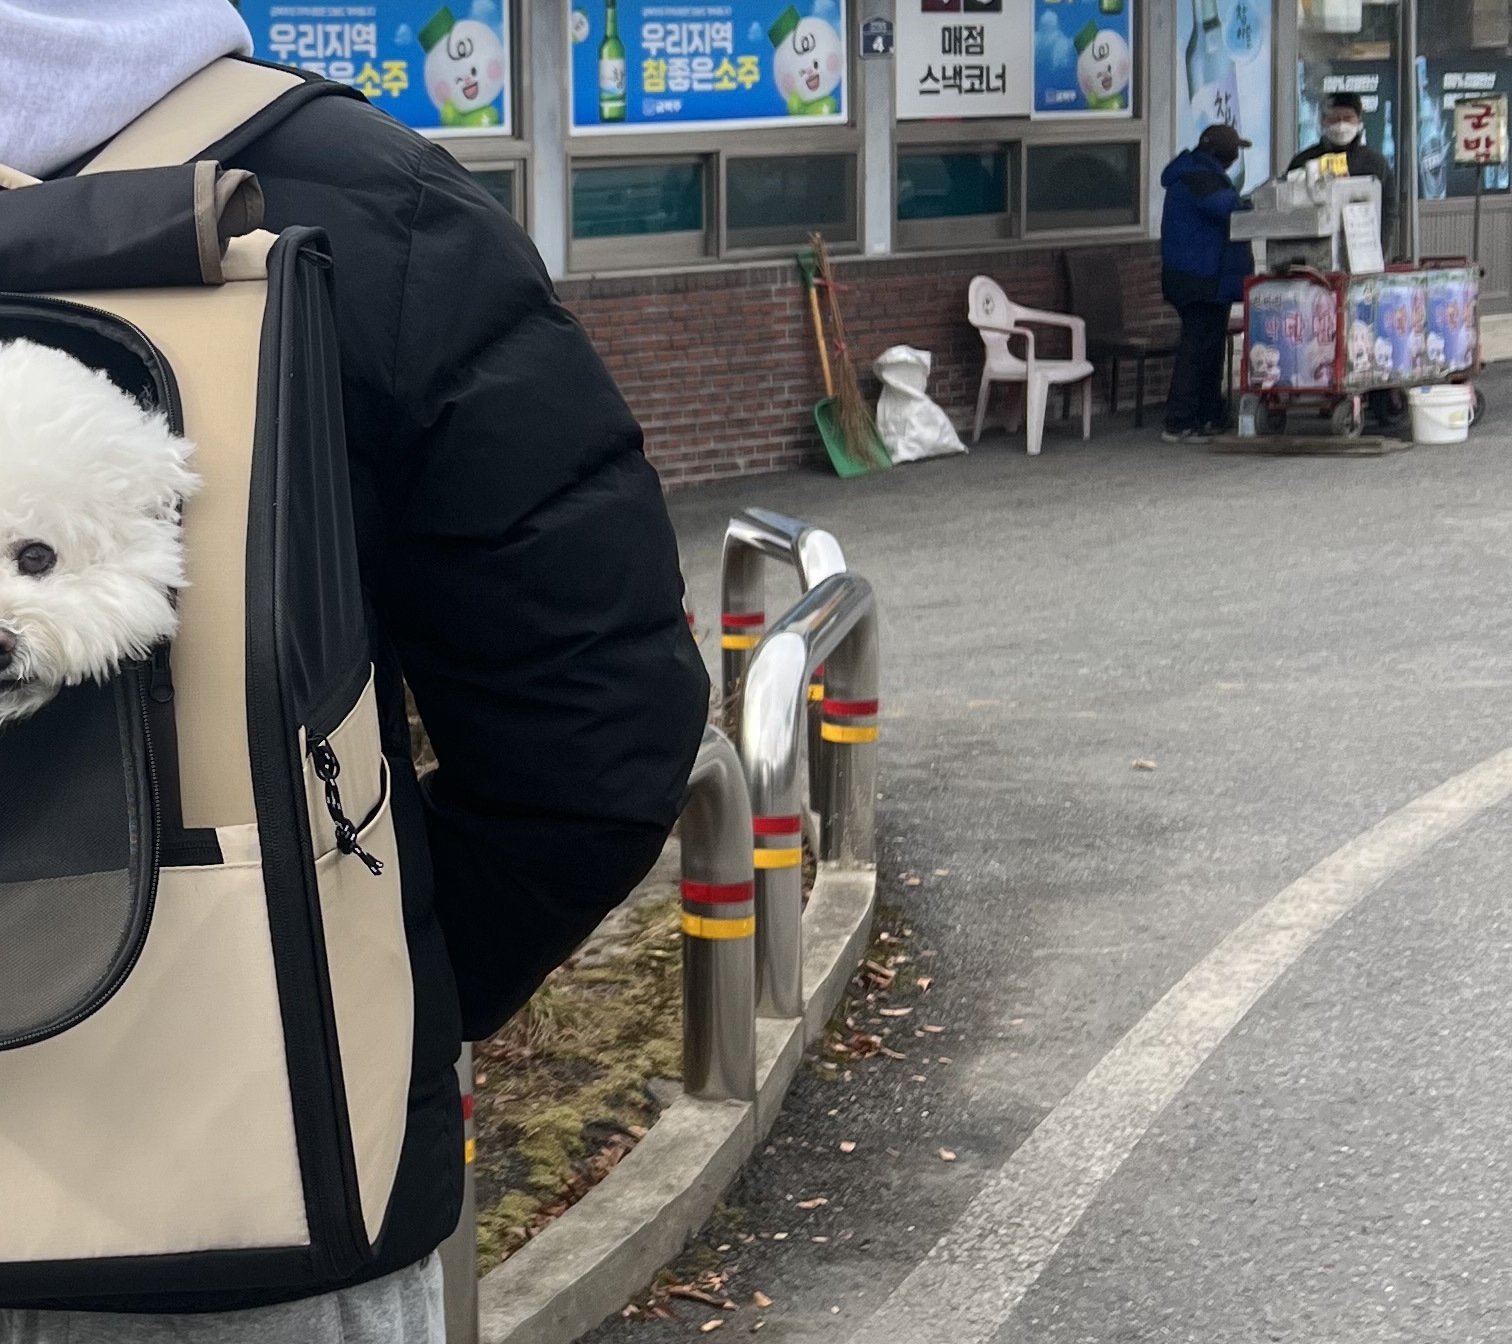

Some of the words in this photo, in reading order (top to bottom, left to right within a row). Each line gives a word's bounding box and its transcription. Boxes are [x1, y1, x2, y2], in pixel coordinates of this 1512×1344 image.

[270, 22, 377, 60] 우리지역
[641, 21, 734, 56] 우리지역
[941, 25, 985, 55] 매점
[919, 63, 1007, 95] 스낵코너
[1464, 103, 1496, 163] 군밤
